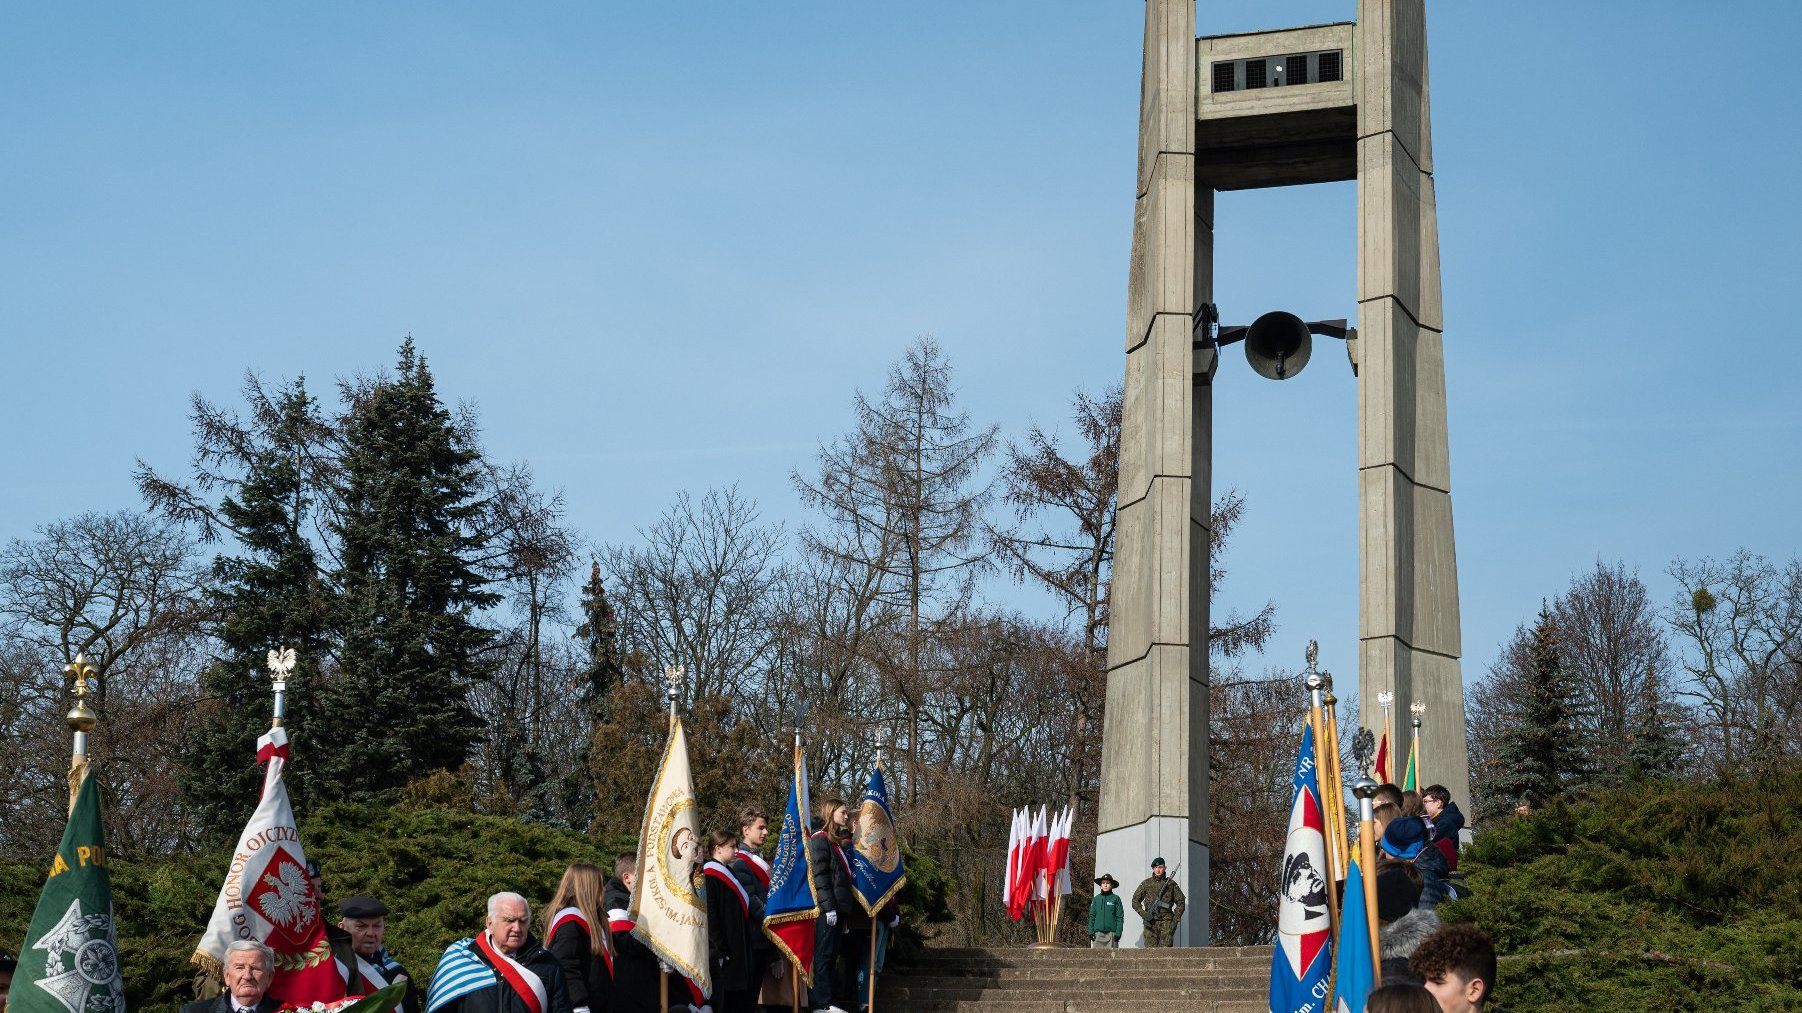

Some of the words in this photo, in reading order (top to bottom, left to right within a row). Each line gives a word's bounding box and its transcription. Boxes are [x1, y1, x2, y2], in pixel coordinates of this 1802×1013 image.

[1298, 757, 1314, 779] NR
[225, 853, 250, 910] HONOR
[246, 826, 299, 851] OJCZYZ
